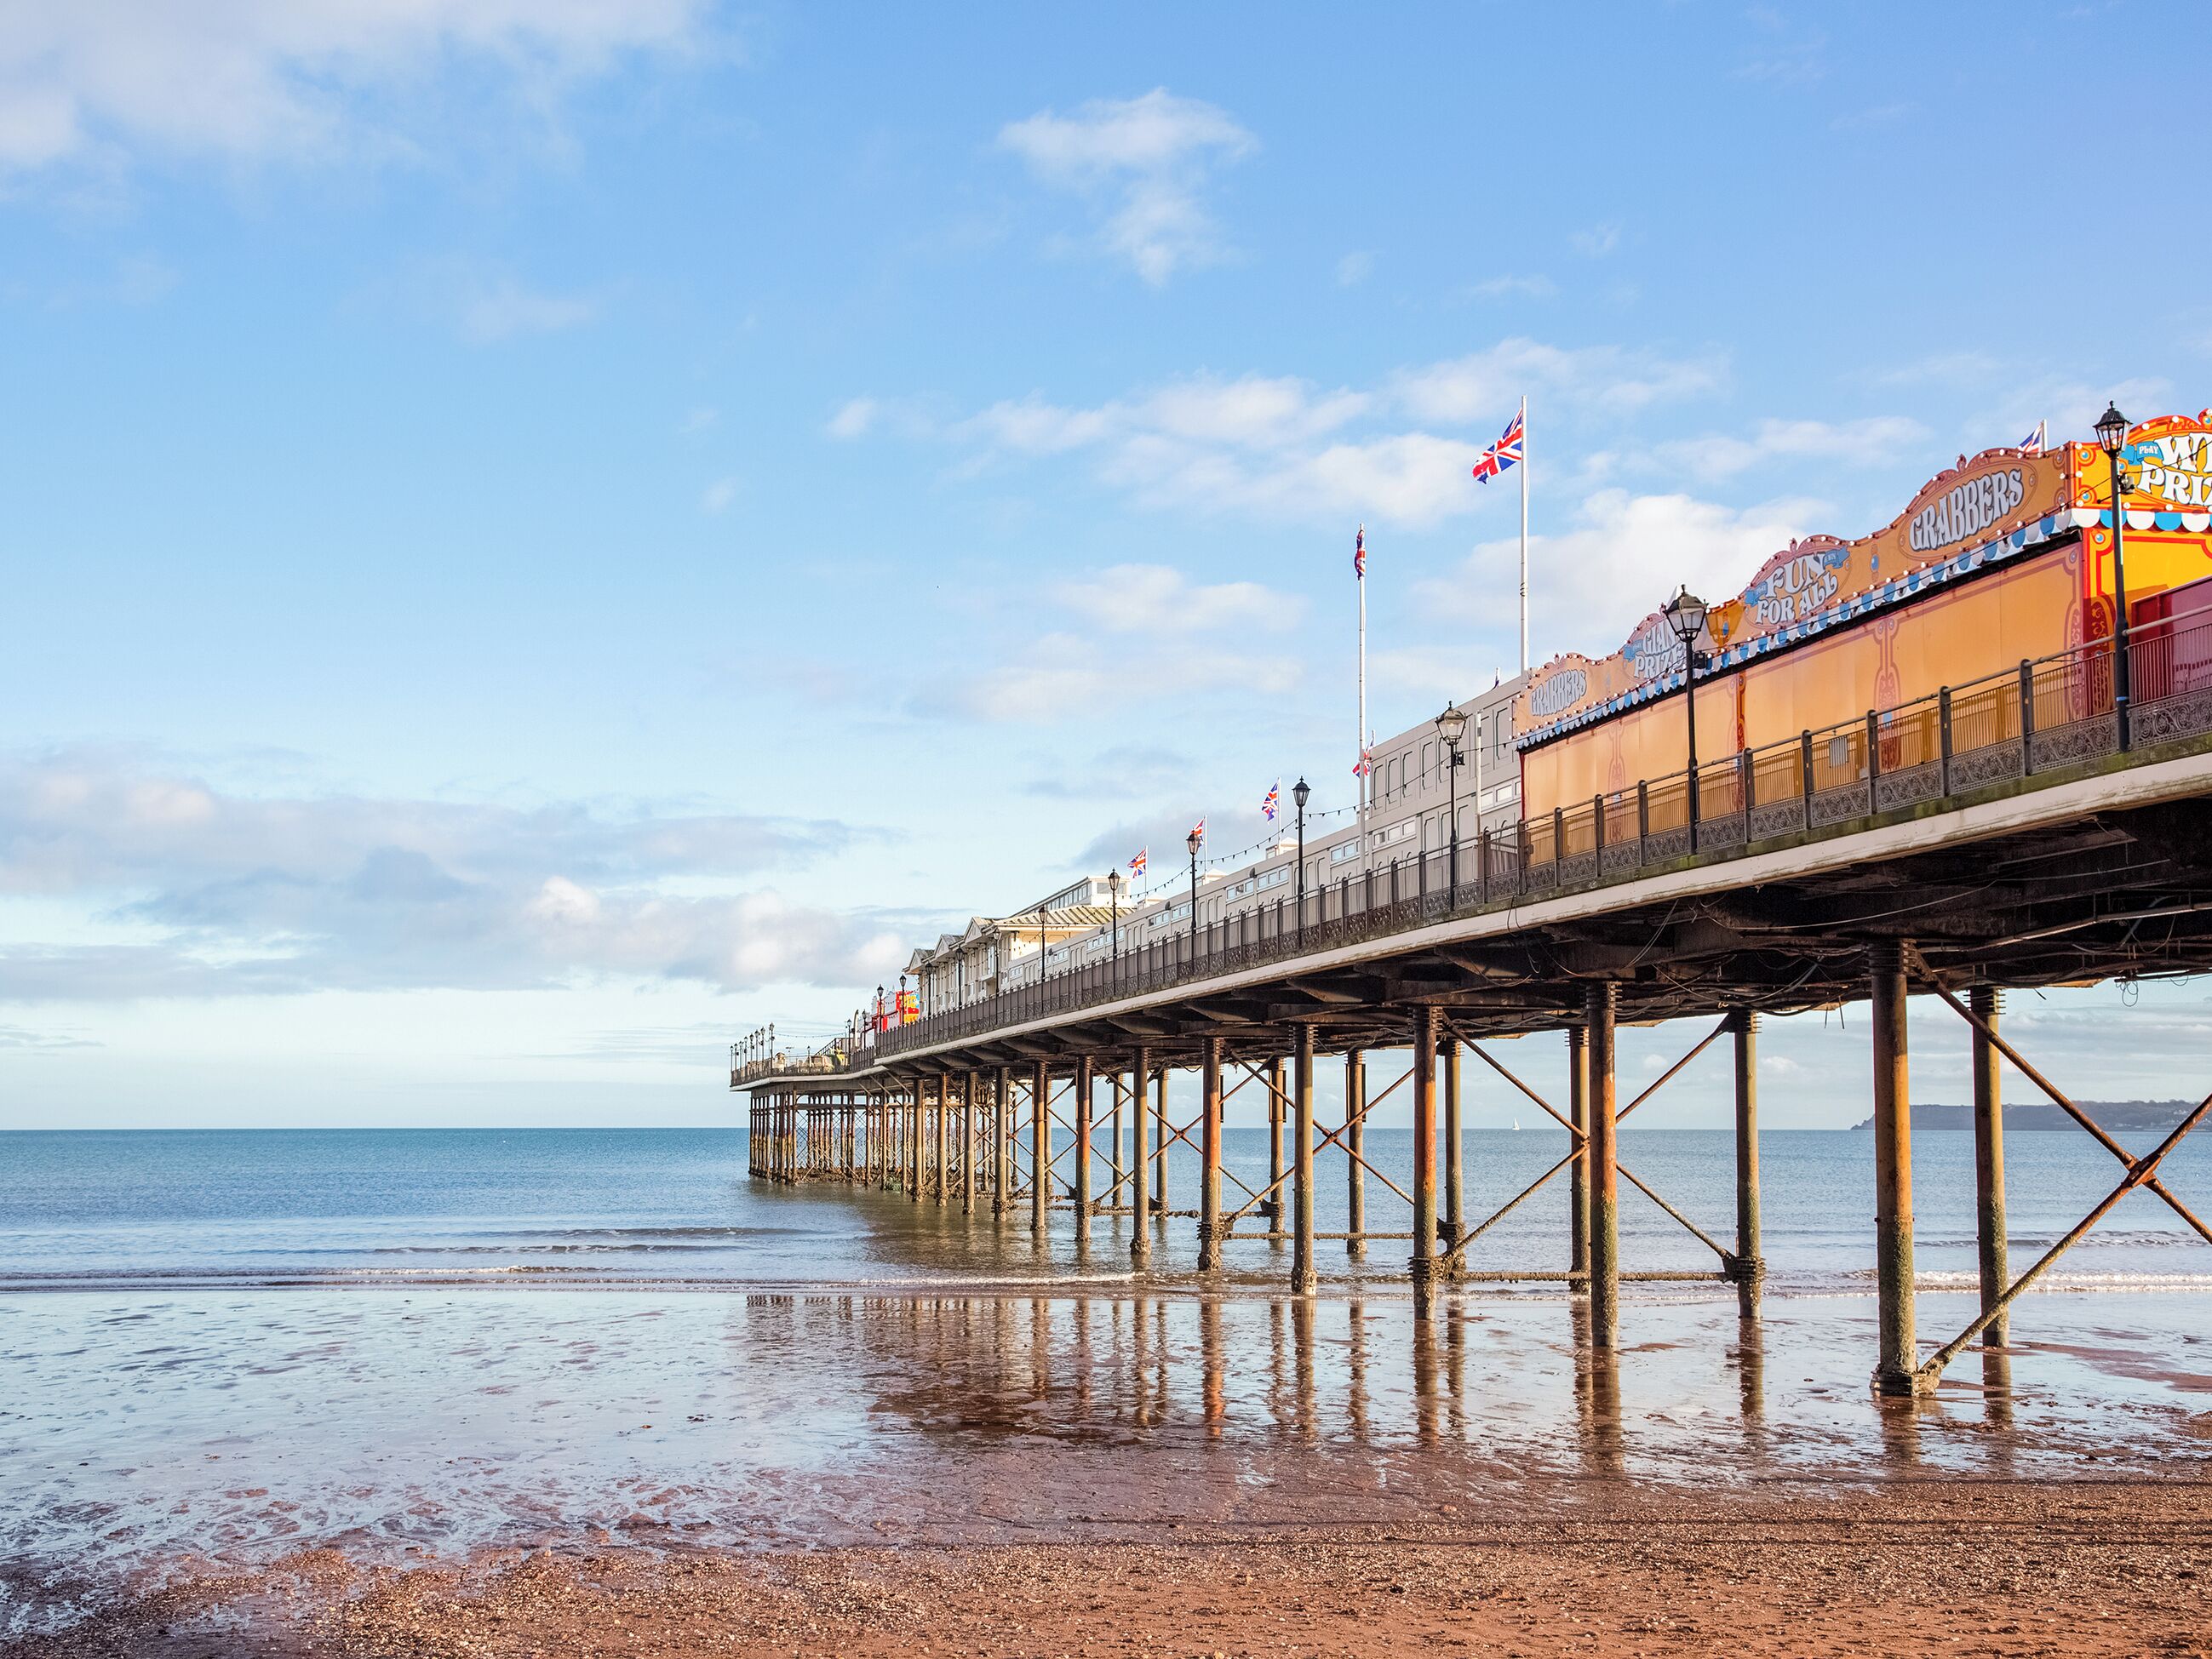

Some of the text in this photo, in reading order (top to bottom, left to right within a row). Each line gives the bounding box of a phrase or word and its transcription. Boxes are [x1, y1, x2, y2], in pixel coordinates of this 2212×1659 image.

[2138, 444, 2158, 455] PLAY
[1910, 468, 2024, 552] GRABBERS
[1756, 570, 1838, 626] FOR ALL
[1765, 551, 1826, 598] FUN
[1633, 641, 1687, 680] PRIZE
[1642, 618, 1678, 656] GIAN
[1531, 669, 1587, 717] GRABBERS
